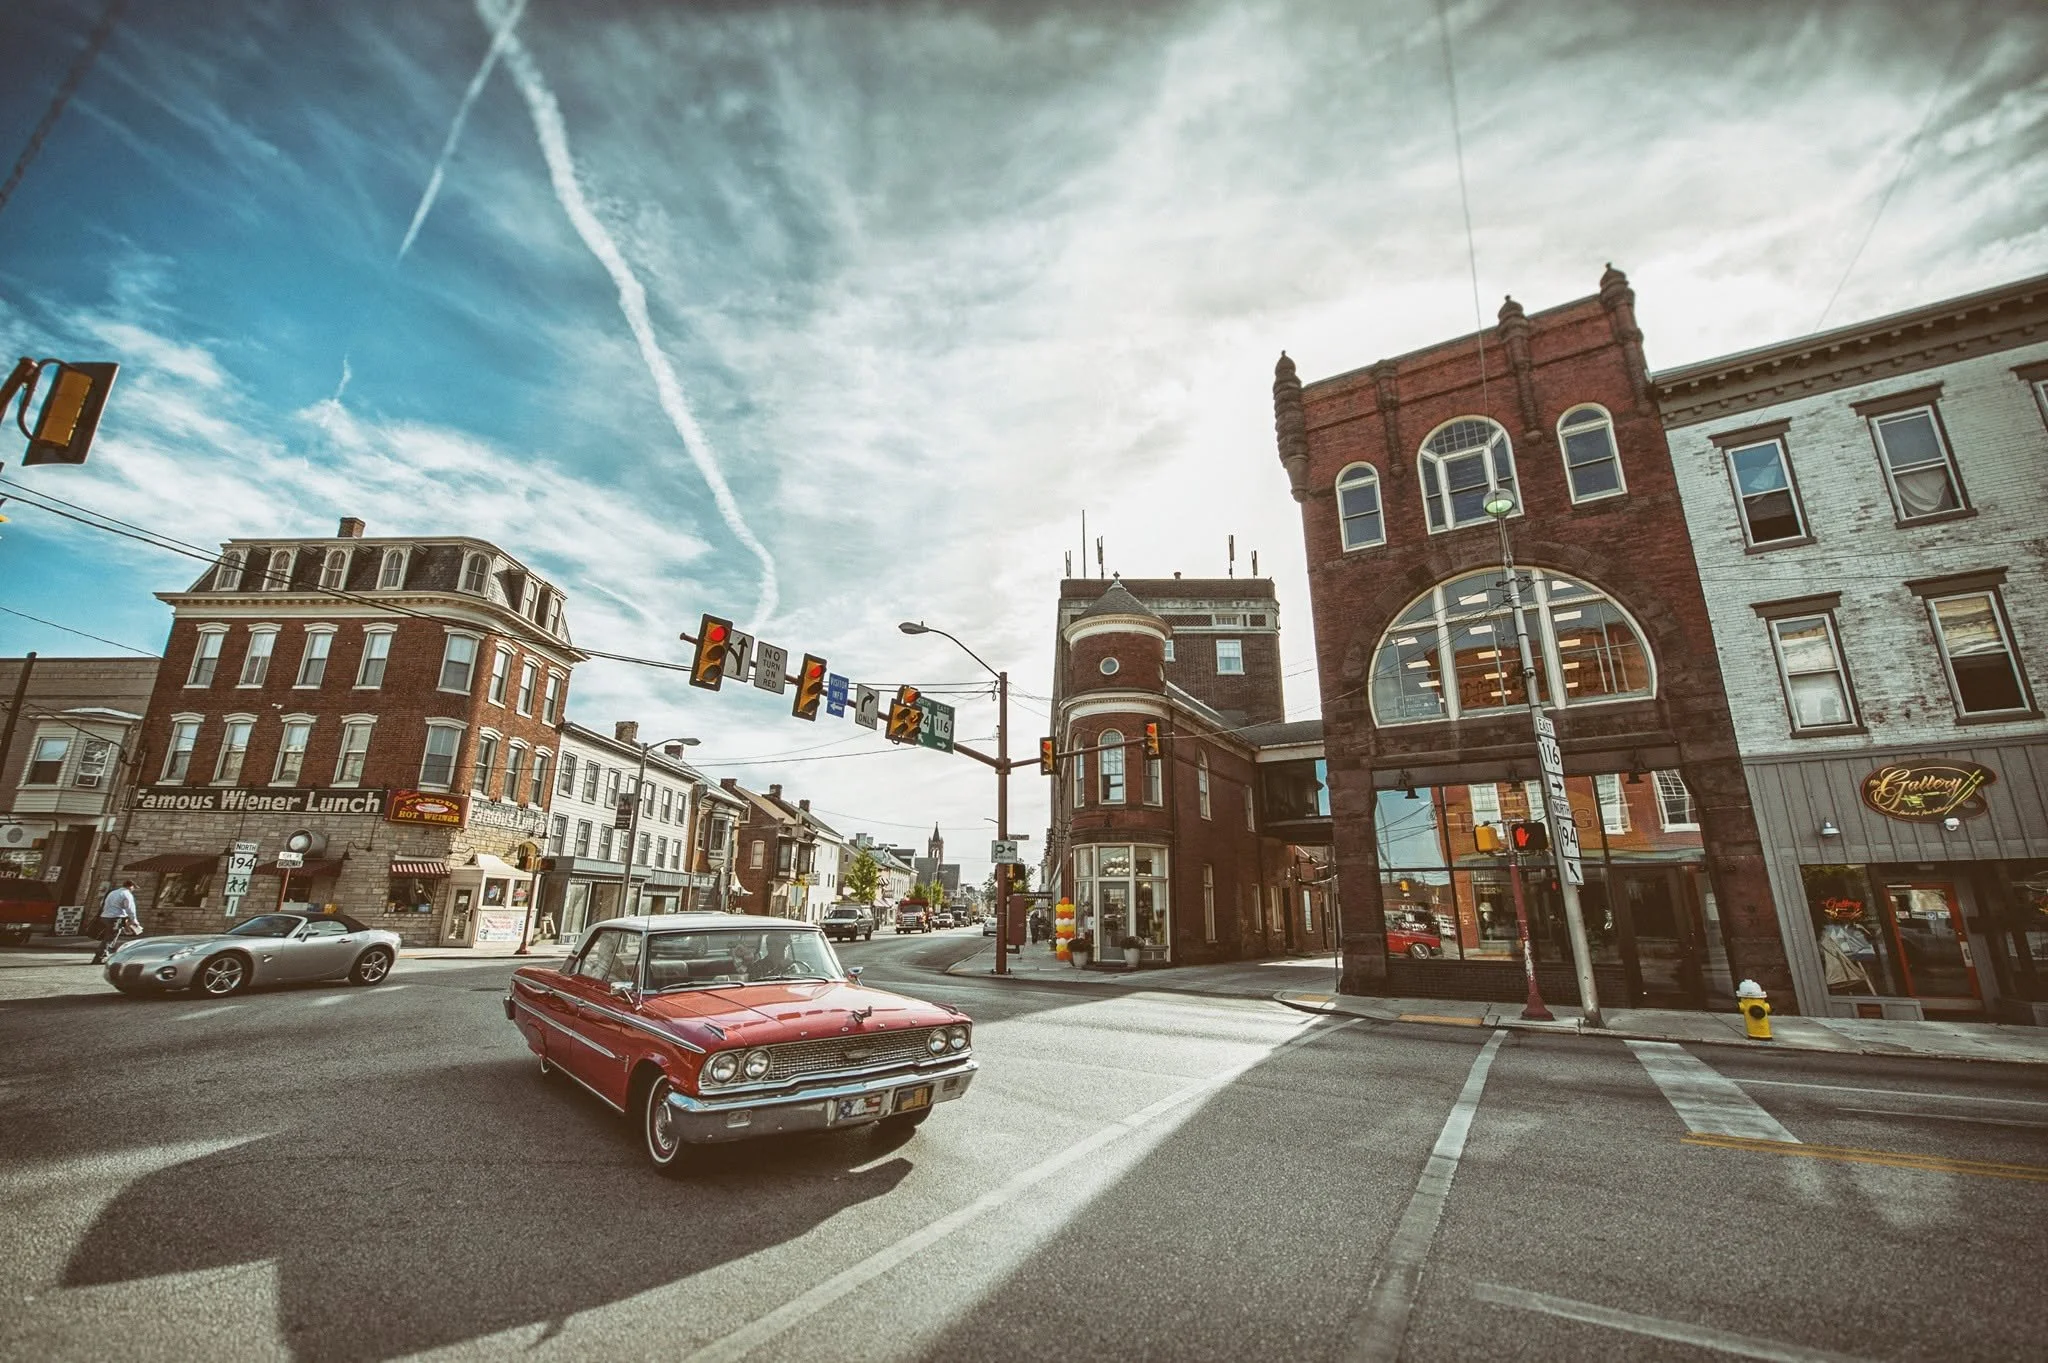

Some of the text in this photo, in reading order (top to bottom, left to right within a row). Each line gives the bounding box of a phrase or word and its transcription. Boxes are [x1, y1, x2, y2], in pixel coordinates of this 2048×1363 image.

[765, 648, 780, 661] NO
[763, 659, 781, 671] TURN
[765, 670, 776, 679] ON
[763, 679, 777, 689] RED
[831, 678, 848, 689] VISITOR
[832, 690, 844, 701] INFO
[936, 704, 951, 714] EAST
[858, 714, 875, 725] ONLY
[936, 718, 949, 733] 116
[1538, 718, 1552, 734] EAST
[1541, 743, 1560, 766] 116
[1870, 767, 1962, 811] Gallery
[135, 788, 215, 810] Famous
[220, 789, 301, 812] Wiener
[305, 791, 381, 813] Lunch
[405, 797, 459, 811] FAMOUS
[1552, 800, 1570, 815] NORTH
[398, 810, 419, 819] HOT
[1559, 826, 1578, 848] 194
[235, 843, 257, 851] NORTH
[230, 857, 254, 870] 194
